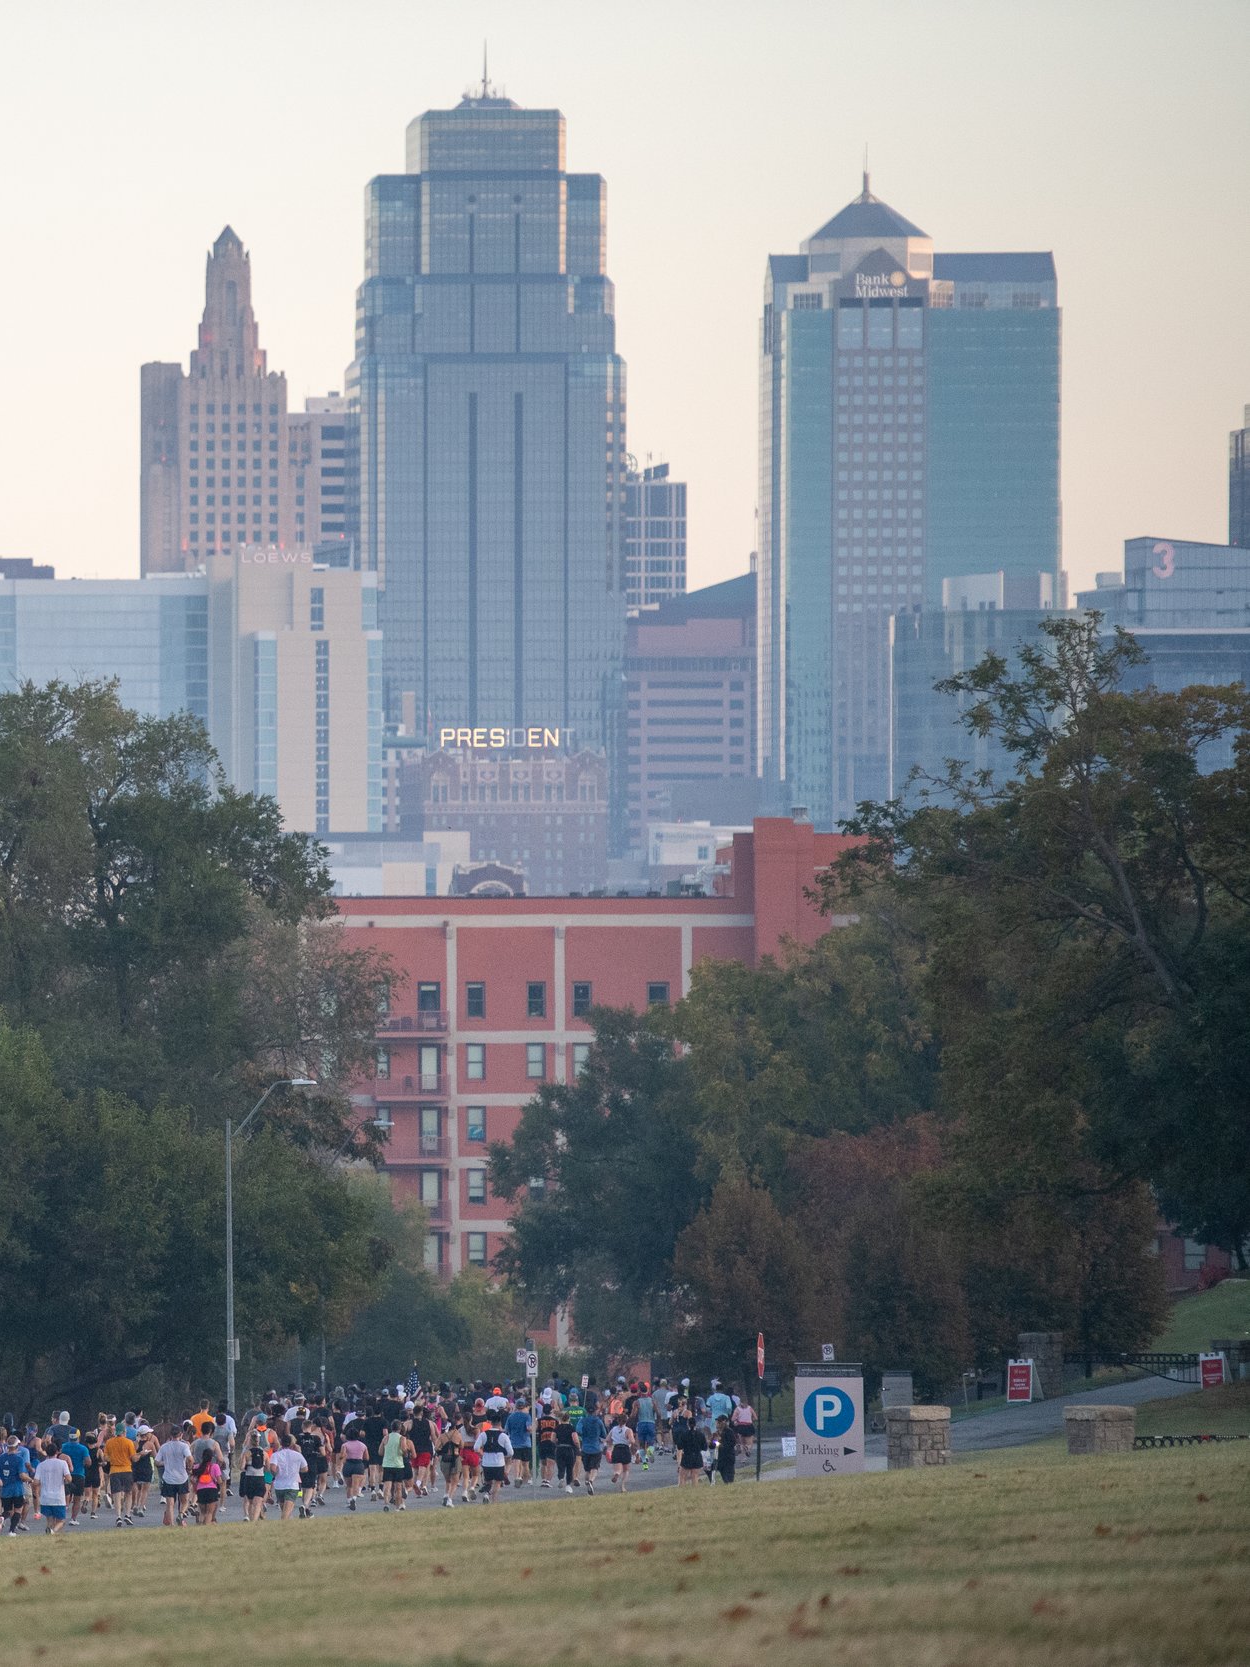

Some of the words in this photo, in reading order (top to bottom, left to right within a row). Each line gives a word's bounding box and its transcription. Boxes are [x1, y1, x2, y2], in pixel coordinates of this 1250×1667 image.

[855, 273, 890, 285] Bank
[855, 285, 908, 298] Midwest
[241, 552, 312, 563] LOEWS
[1152, 542, 1176, 579] 3
[440, 727, 575, 748] PRESIDENT
[815, 1394, 842, 1431] P
[801, 1444, 840, 1457] Parking
